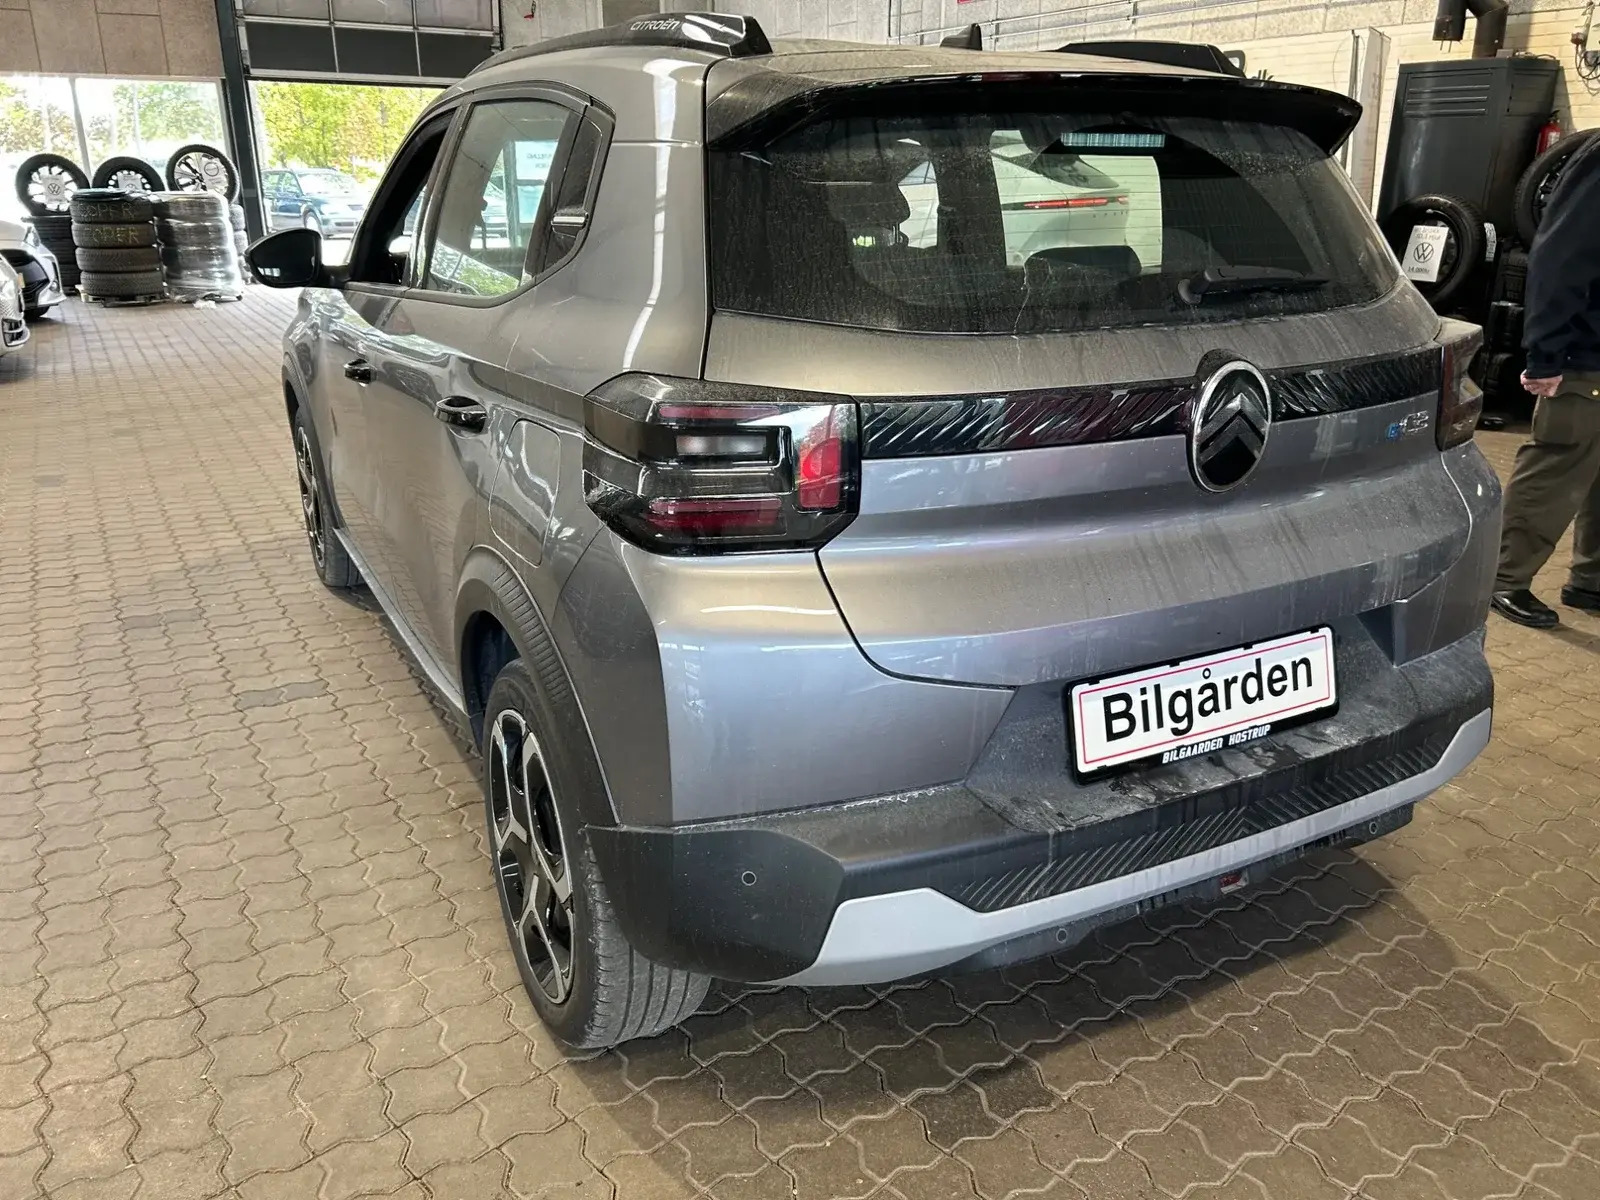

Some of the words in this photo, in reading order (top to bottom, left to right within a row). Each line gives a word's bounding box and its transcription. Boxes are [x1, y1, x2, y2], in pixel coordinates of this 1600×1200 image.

[1102, 656, 1313, 743] Bilgården
[1162, 738, 1224, 764] BILGAARDEN
[1228, 724, 1271, 746] HOSTRUP
